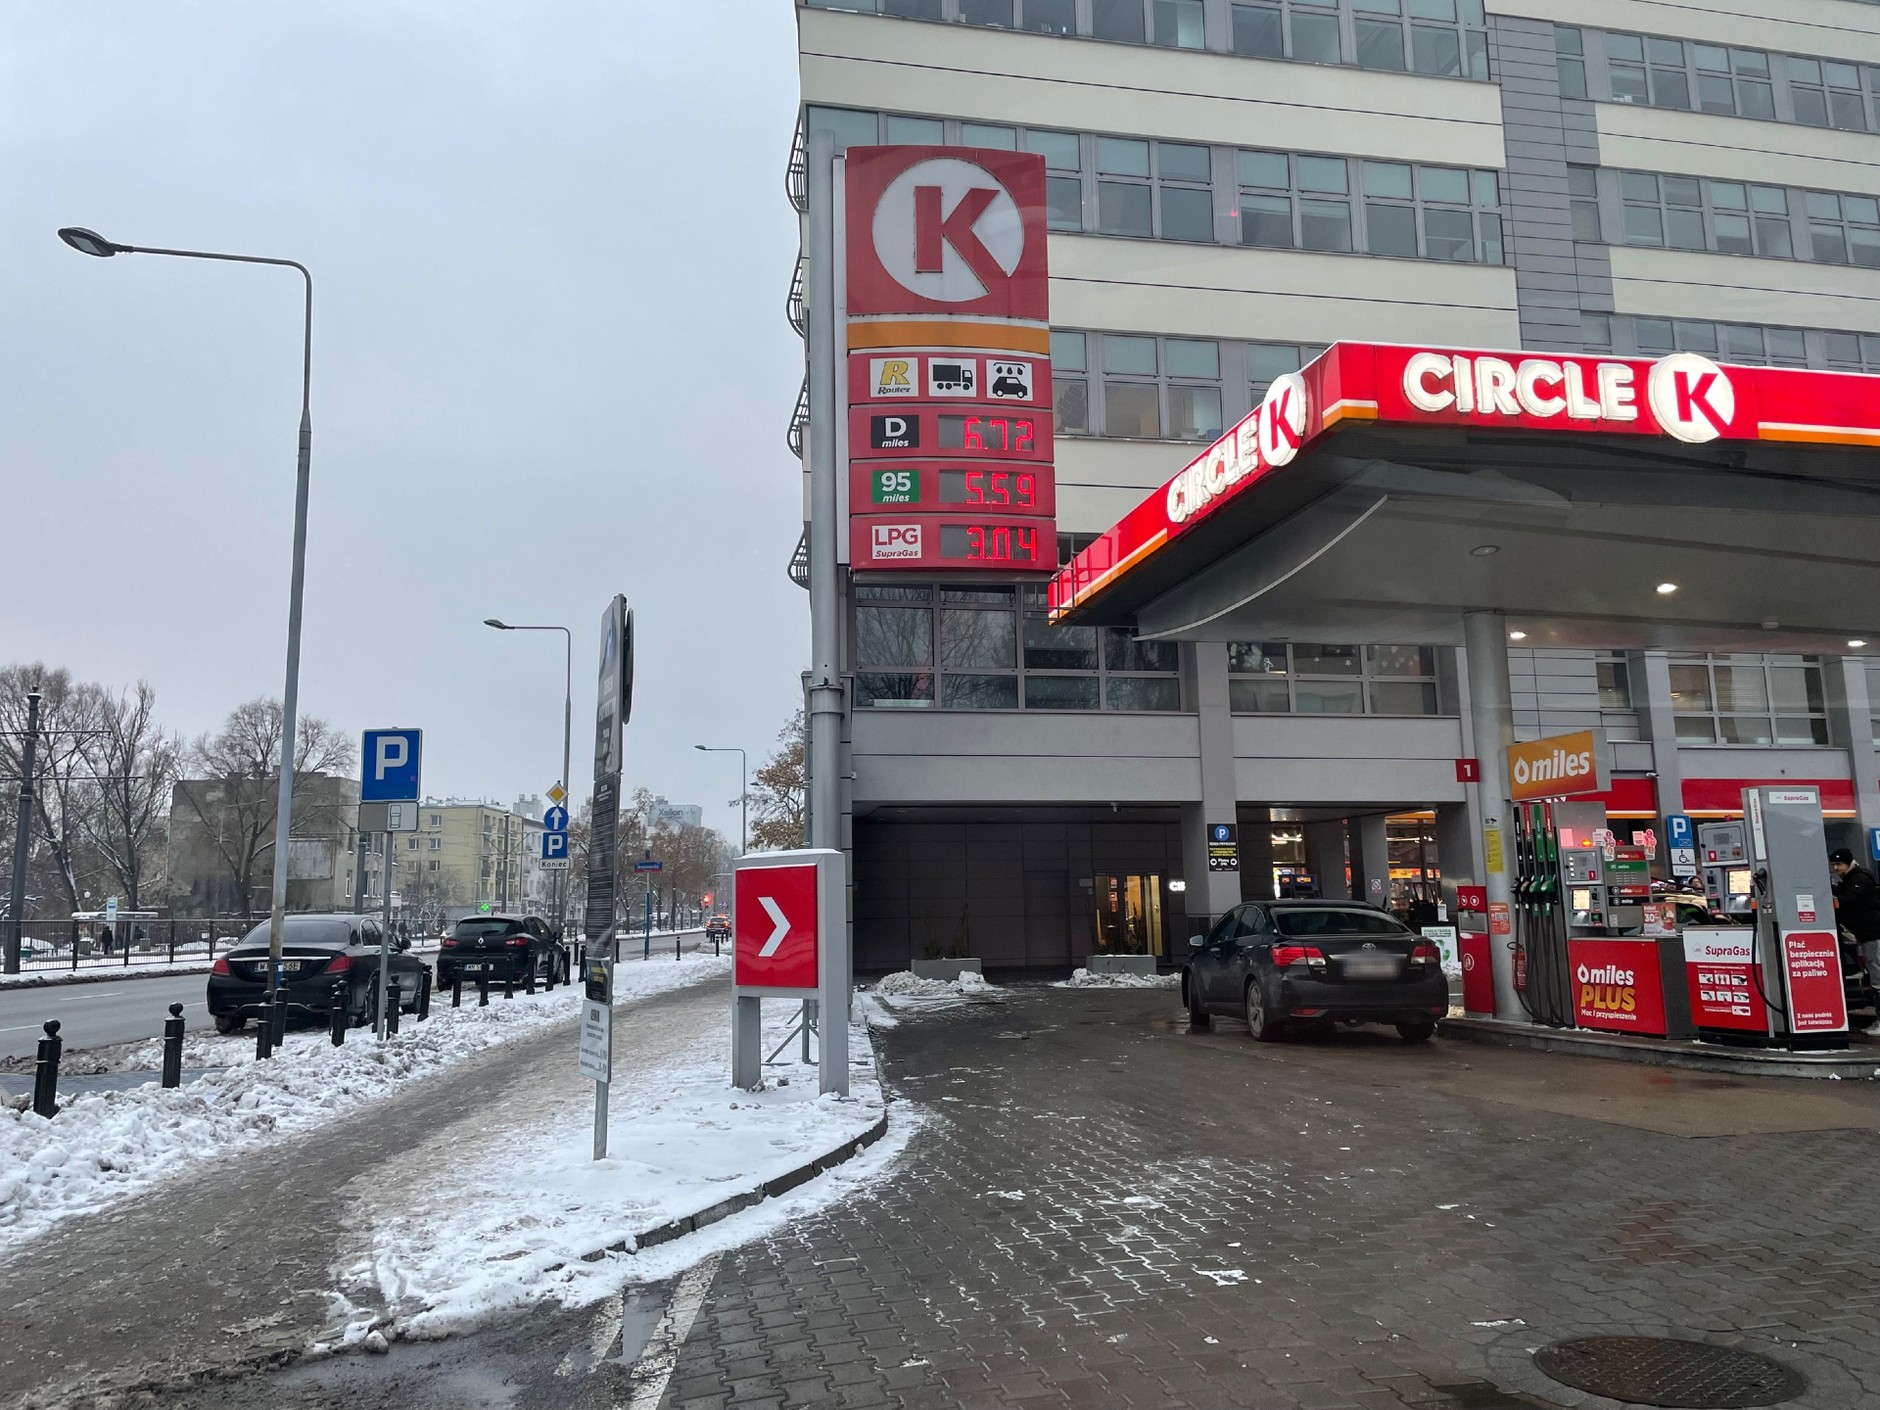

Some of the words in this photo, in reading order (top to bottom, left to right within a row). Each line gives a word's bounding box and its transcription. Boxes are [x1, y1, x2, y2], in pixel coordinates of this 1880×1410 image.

[914, 186, 1010, 295] K
[880, 360, 910, 385] R
[877, 386, 910, 395] Routex
[1403, 352, 1638, 421] CIRCLE
[1673, 371, 1730, 437] K
[884, 417, 907, 437] D
[964, 417, 1033, 451] 6.72
[881, 439, 910, 448] miles
[1166, 414, 1260, 523] CIRCLE
[1270, 386, 1301, 453] K
[881, 472, 911, 491] 95
[965, 472, 1035, 506] 5.59
[882, 494, 910, 502] miles
[874, 528, 919, 546] LPG
[966, 526, 1036, 561] 3.04
[875, 550, 919, 558] SupraGas
[375, 735, 408, 780] P
[1532, 750, 1590, 782] miles
[1464, 764, 1472, 777] 1
[1218, 829, 1226, 838] P
[1672, 818, 1687, 838] P
[547, 834, 563, 855] P
[541, 860, 567, 868] Koniec
[1644, 914, 1655, 922] 30
[1705, 946, 1750, 957] SupraGas
[1788, 941, 1806, 949] Płać
[1789, 950, 1834, 959] bezpiecznie
[1791, 960, 1825, 969] aplikacją
[1802, 969, 1828, 978] paliwo
[1590, 965, 1634, 986] miles
[1580, 985, 1636, 1012] PLUS
[1581, 1009, 1592, 1017] Moc
[1596, 1011, 1637, 1021] przyspieszenie
